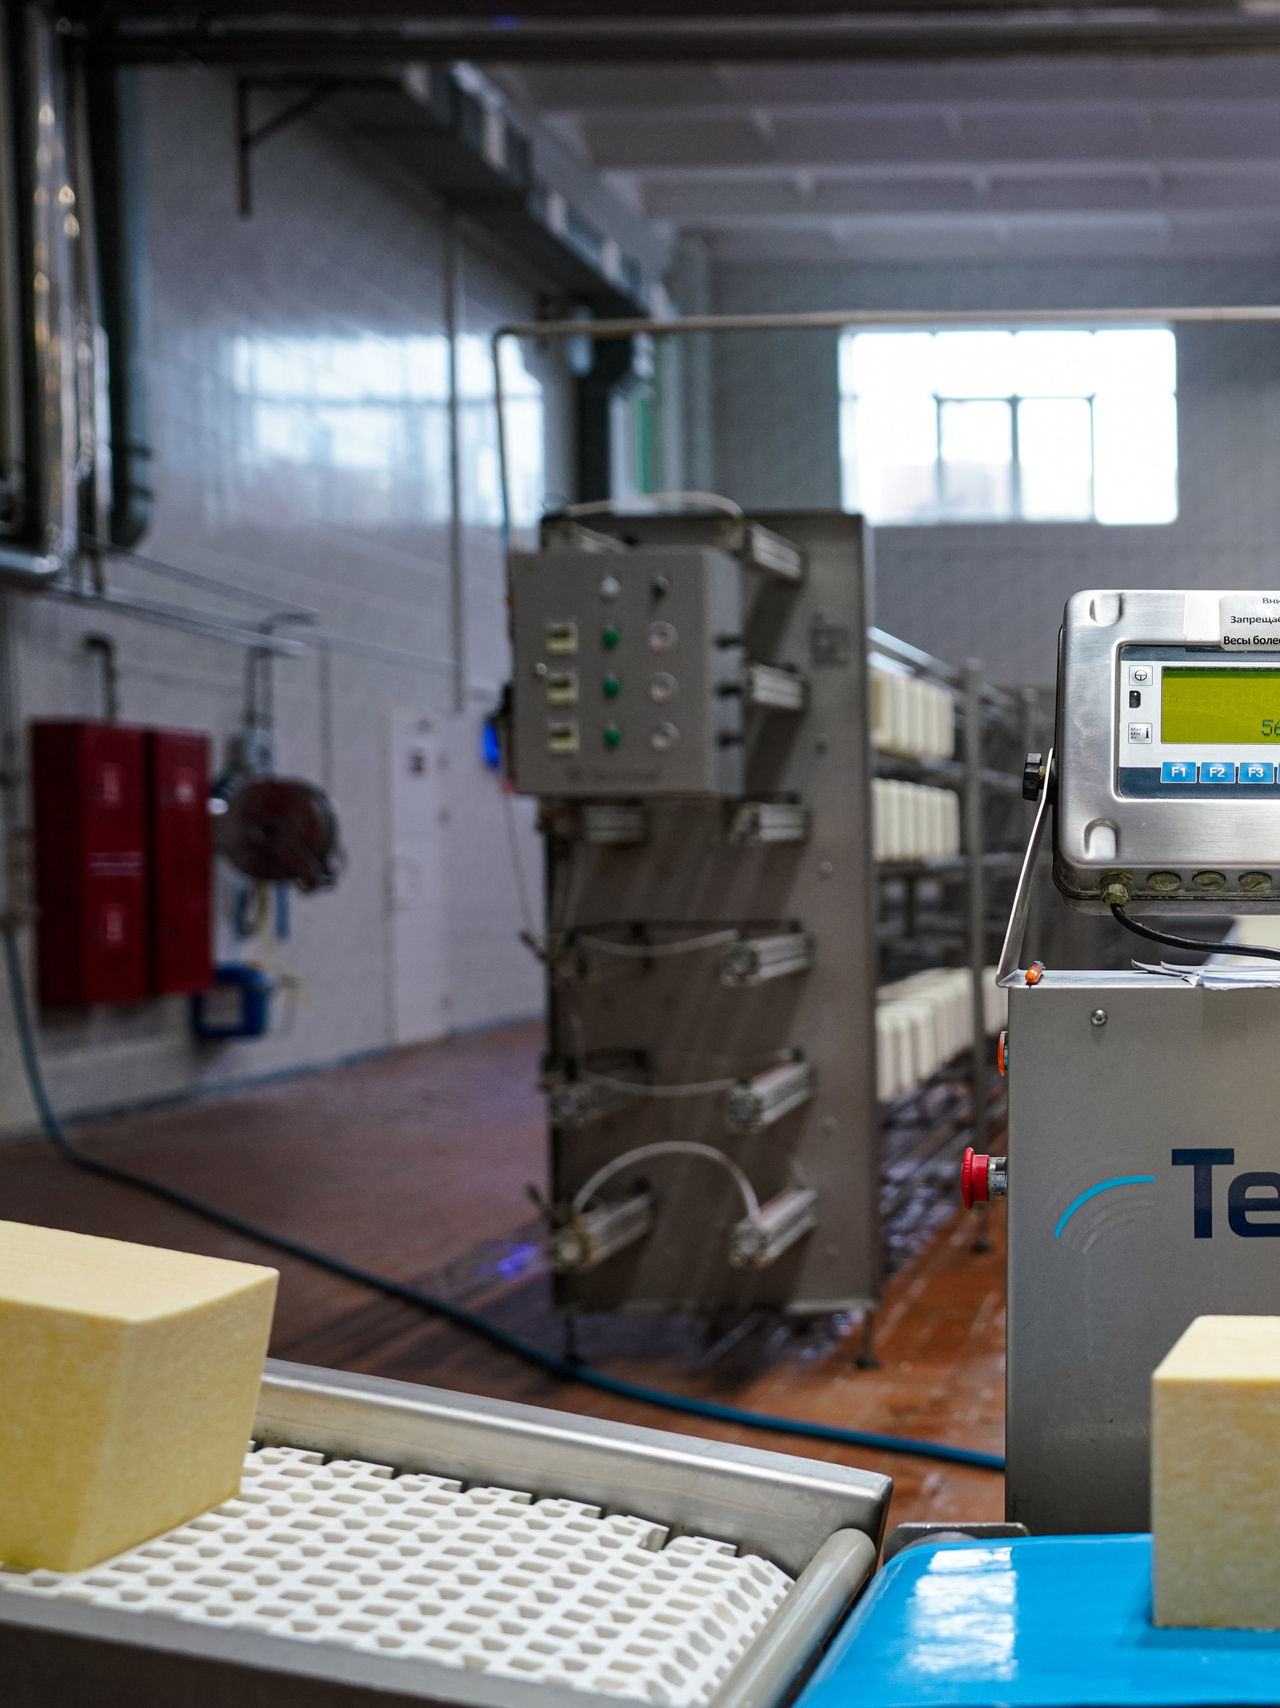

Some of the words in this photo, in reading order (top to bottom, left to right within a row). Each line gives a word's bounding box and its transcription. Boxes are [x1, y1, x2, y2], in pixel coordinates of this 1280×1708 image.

[1223, 635, 1251, 645] Весы
[1171, 767, 1186, 778] F1
[1209, 767, 1225, 778] F2
[1248, 767, 1264, 778] F3
